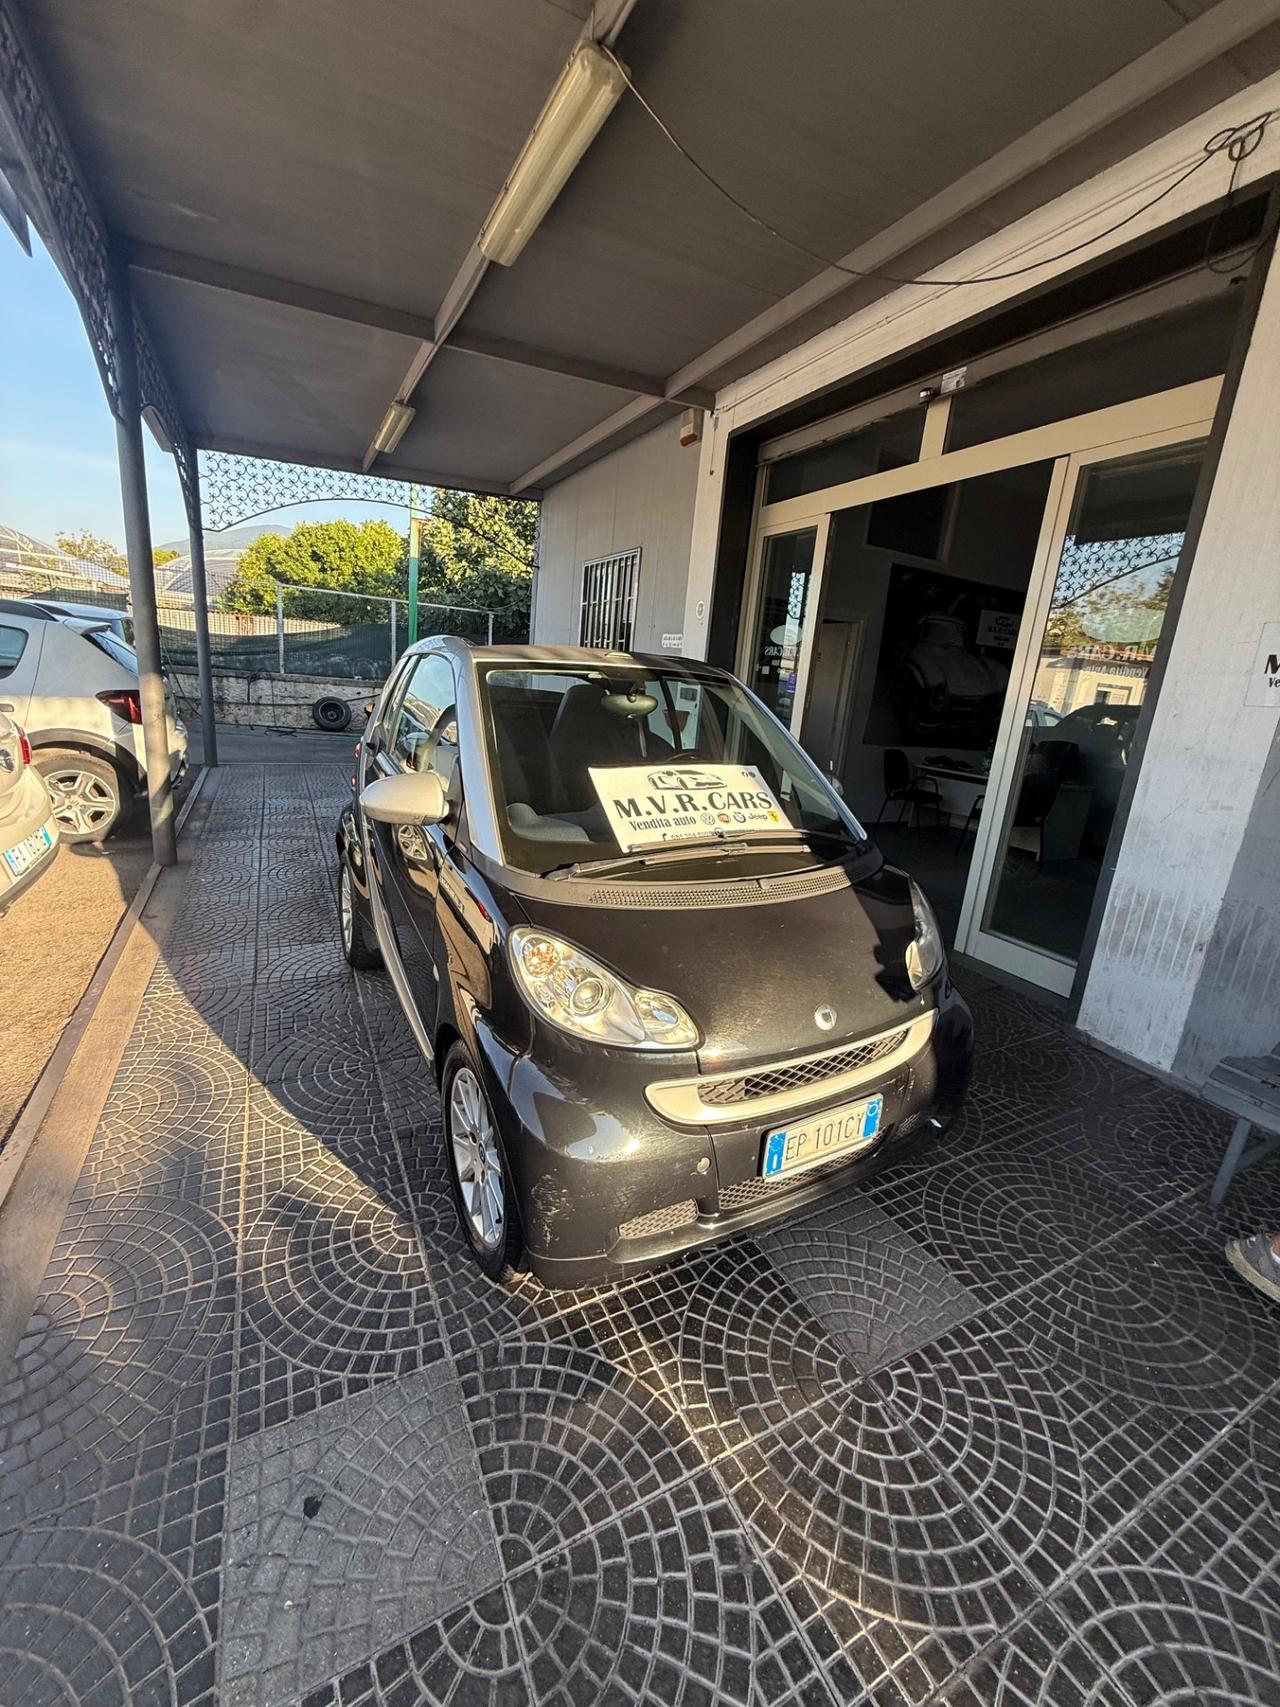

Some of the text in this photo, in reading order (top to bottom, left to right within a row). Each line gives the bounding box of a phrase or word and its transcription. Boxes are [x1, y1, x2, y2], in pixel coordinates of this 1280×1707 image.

[629, 815, 697, 832] Vendita auto
[748, 812, 768, 822] Jeep
[785, 1132, 808, 1161] EP
